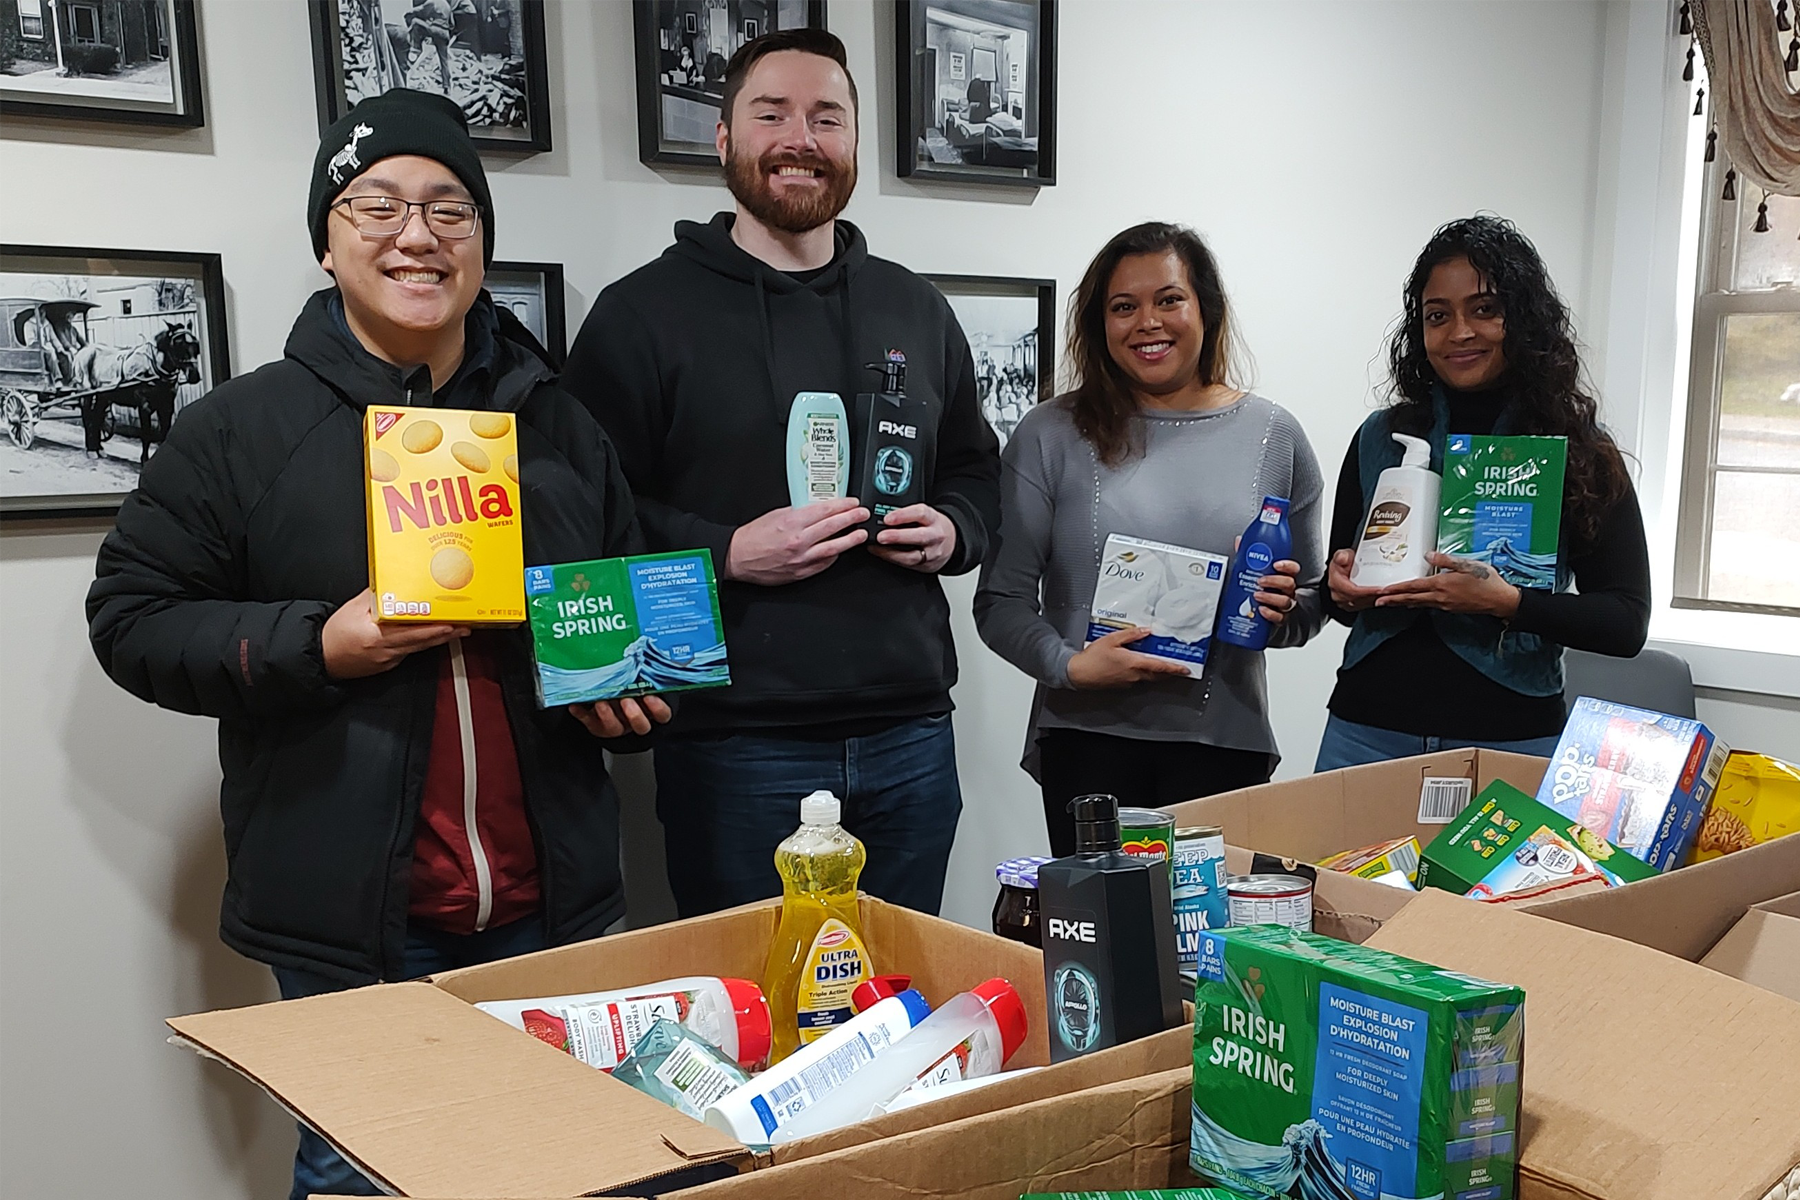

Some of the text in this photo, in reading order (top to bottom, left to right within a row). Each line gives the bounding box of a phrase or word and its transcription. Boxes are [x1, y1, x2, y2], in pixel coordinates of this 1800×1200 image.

[812, 434, 836, 442] Blends
[879, 421, 916, 438] AXE
[1484, 466, 1531, 480] IRISH
[1475, 482, 1538, 497] SPRING
[382, 476, 513, 533] Nilla
[488, 520, 514, 528] WAFERS
[428, 532, 464, 544] DELICIOUS
[1248, 552, 1268, 562] NIVEA
[534, 570, 543, 579] 8
[637, 566, 672, 575] MOISTURE
[648, 572, 688, 581] EXPLOSION
[1104, 560, 1144, 581] Dove
[641, 578, 697, 590] D'HYDRATATION
[558, 595, 614, 618] IRISH
[1097, 608, 1127, 619] original
[552, 614, 626, 638] SPRING
[1552, 746, 1580, 804] pop
[1574, 754, 1595, 796] tarts
[1174, 849, 1208, 866] EEP
[1175, 868, 1204, 884] EA
[1049, 918, 1096, 942] AXE
[1205, 938, 1214, 955] 8
[822, 949, 858, 962] ULTRA
[1202, 954, 1220, 966] BARS
[816, 960, 861, 981] DISH
[1200, 963, 1221, 975] PAINS
[1065, 1001, 1087, 1010] APOLLO
[1329, 996, 1415, 1032] MOISTURE BLAST
[630, 1004, 642, 1040] STRAWB
[1222, 1004, 1285, 1052] IRISH
[1343, 1015, 1398, 1041] EXPLOSION
[1475, 1026, 1490, 1034] IRISH
[572, 1019, 585, 1060] BODY WASH
[612, 1014, 625, 1055] UPLIFTING
[626, 1015, 635, 1048] DELIGH
[1472, 1033, 1492, 1042] SPRING
[1330, 1025, 1410, 1060] D'HYDRATATION
[1209, 1037, 1294, 1094] SPRING
[1344, 1053, 1361, 1064] FRESH
[1362, 1060, 1392, 1075] DEODORANT
[1393, 1071, 1407, 1080] SOAP
[1347, 1066, 1388, 1087] FOR DEEPLY
[1336, 1072, 1399, 1101] MOISTURIZED SKIN
[1330, 1100, 1353, 1112] OFFRANT
[1338, 1095, 1355, 1105] SAVON
[1474, 1098, 1490, 1106] IRISH
[1472, 1104, 1493, 1115] SPRING
[1318, 1108, 1340, 1121] POUR
[1340, 1116, 1354, 1126] UNE
[1356, 1121, 1375, 1134] PEAU
[1336, 1123, 1394, 1151] EN PROFONDEUR
[1351, 1164, 1376, 1186] 12HR
[1469, 1175, 1490, 1186] SPRING
[1471, 1168, 1487, 1177] IRISH
